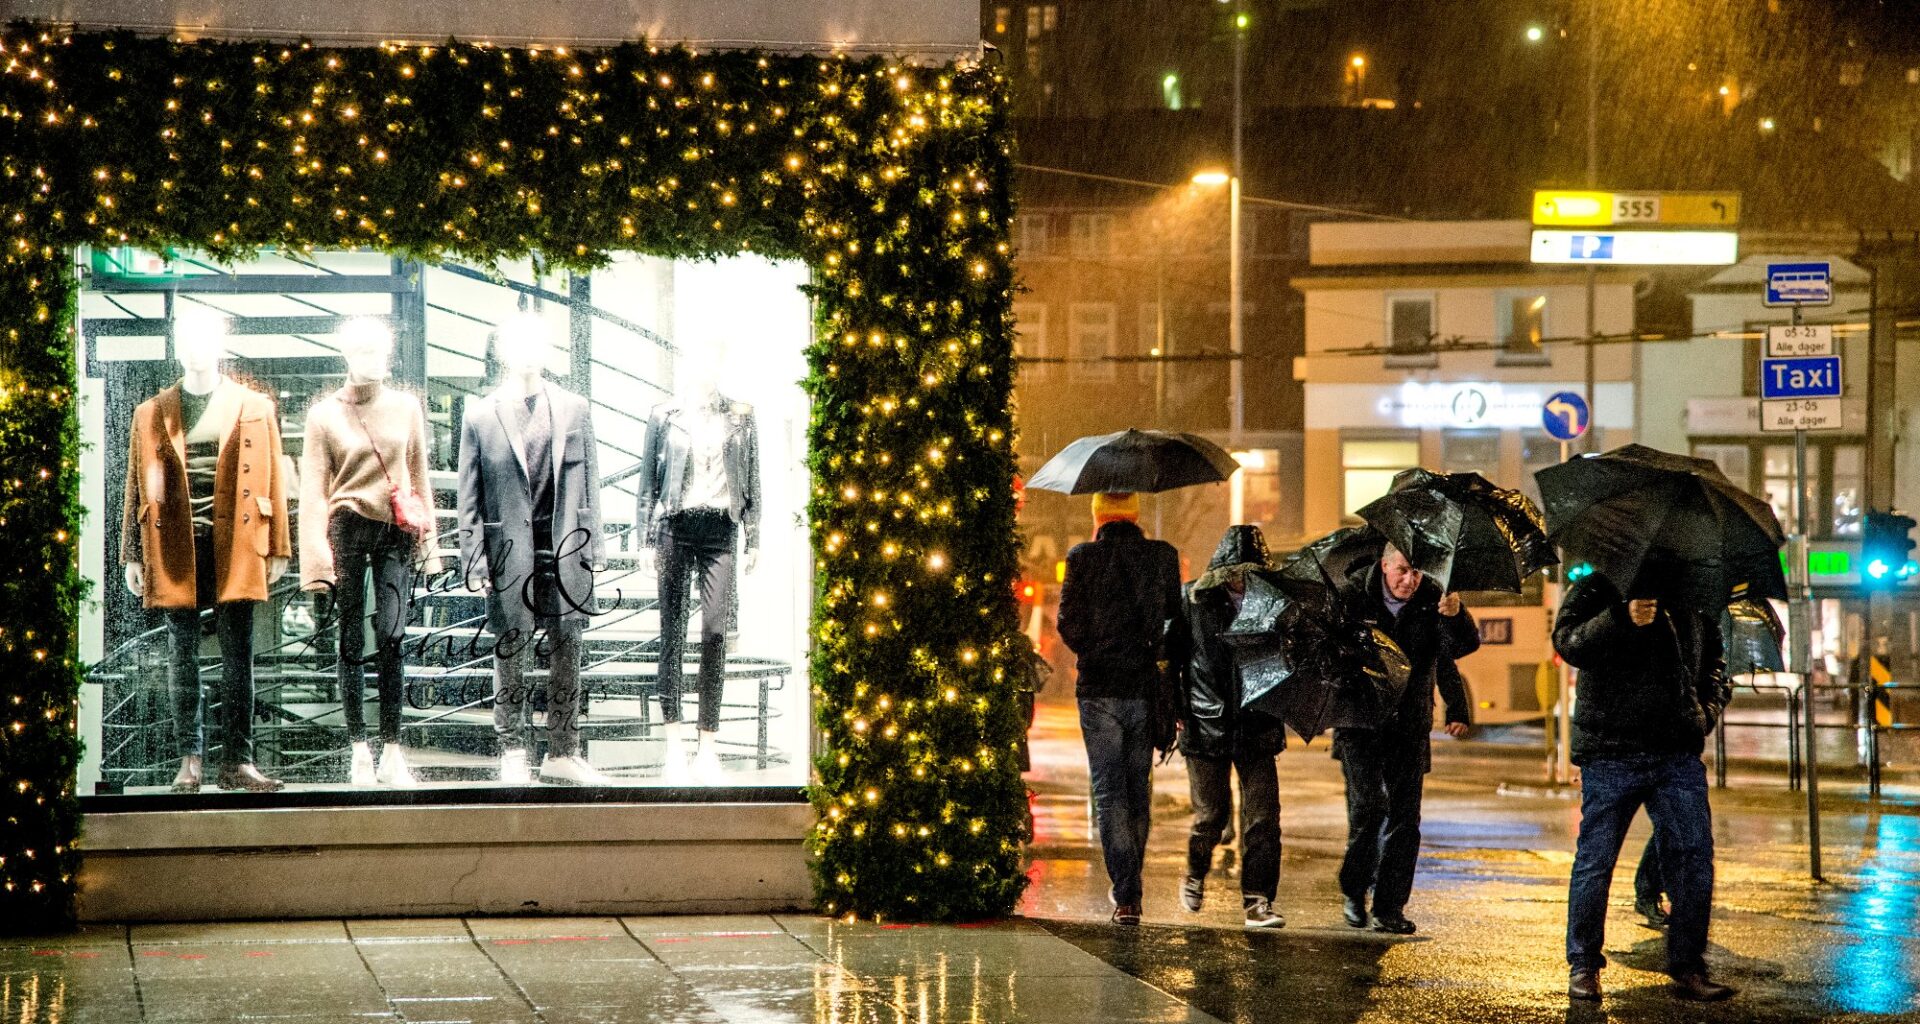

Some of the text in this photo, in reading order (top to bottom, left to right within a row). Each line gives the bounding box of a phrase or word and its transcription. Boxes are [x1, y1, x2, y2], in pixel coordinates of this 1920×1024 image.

[1618, 200, 1654, 218] 555
[1776, 342, 1825, 352] Alle dager
[1770, 362, 1833, 389] Taxi
[1777, 416, 1827, 425] Alle dager
[406, 527, 622, 617] Fall &
[283, 579, 570, 666] Winter
[406, 661, 607, 710] Collections
